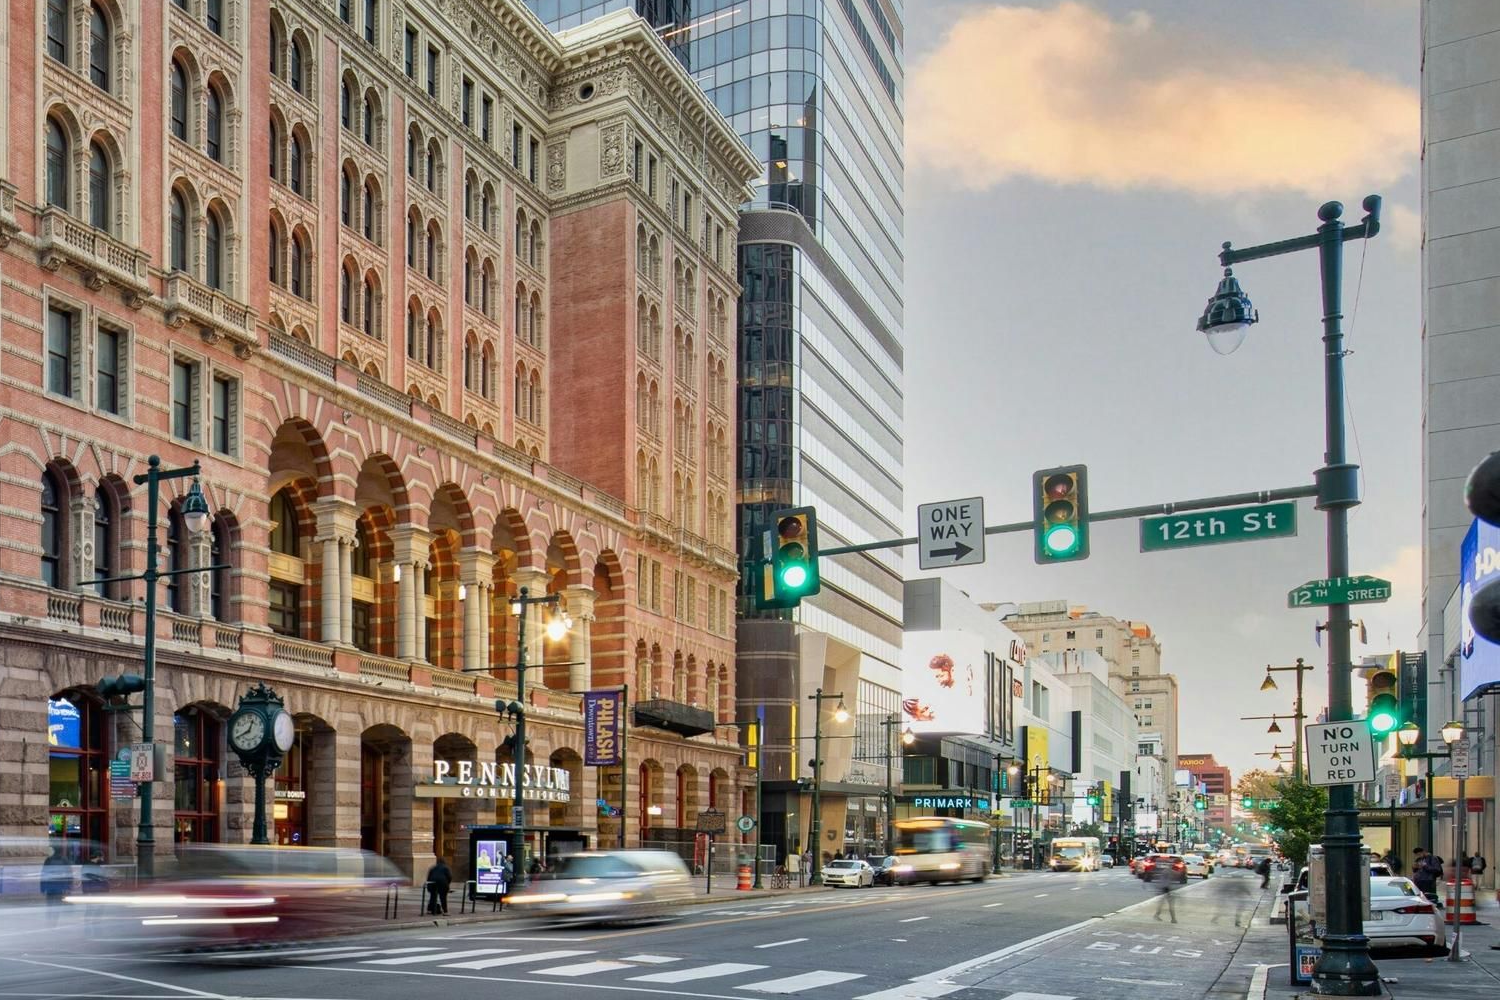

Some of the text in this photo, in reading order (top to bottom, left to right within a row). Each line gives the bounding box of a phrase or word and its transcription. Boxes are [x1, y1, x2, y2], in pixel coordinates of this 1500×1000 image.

[931, 505, 971, 522] ONE
[931, 522, 972, 540] WAY
[1159, 512, 1276, 540] 12th St
[1347, 588, 1389, 600] STREET
[588, 699, 596, 742] Downtown
[597, 698, 614, 759] PHLASH
[1323, 727, 1353, 740] NO
[1320, 742, 1359, 753] TURN
[1330, 756, 1351, 766] ON
[1328, 769, 1356, 779] RED
[915, 798, 972, 808] PRIMARK
[1085, 941, 1204, 958] BUS
